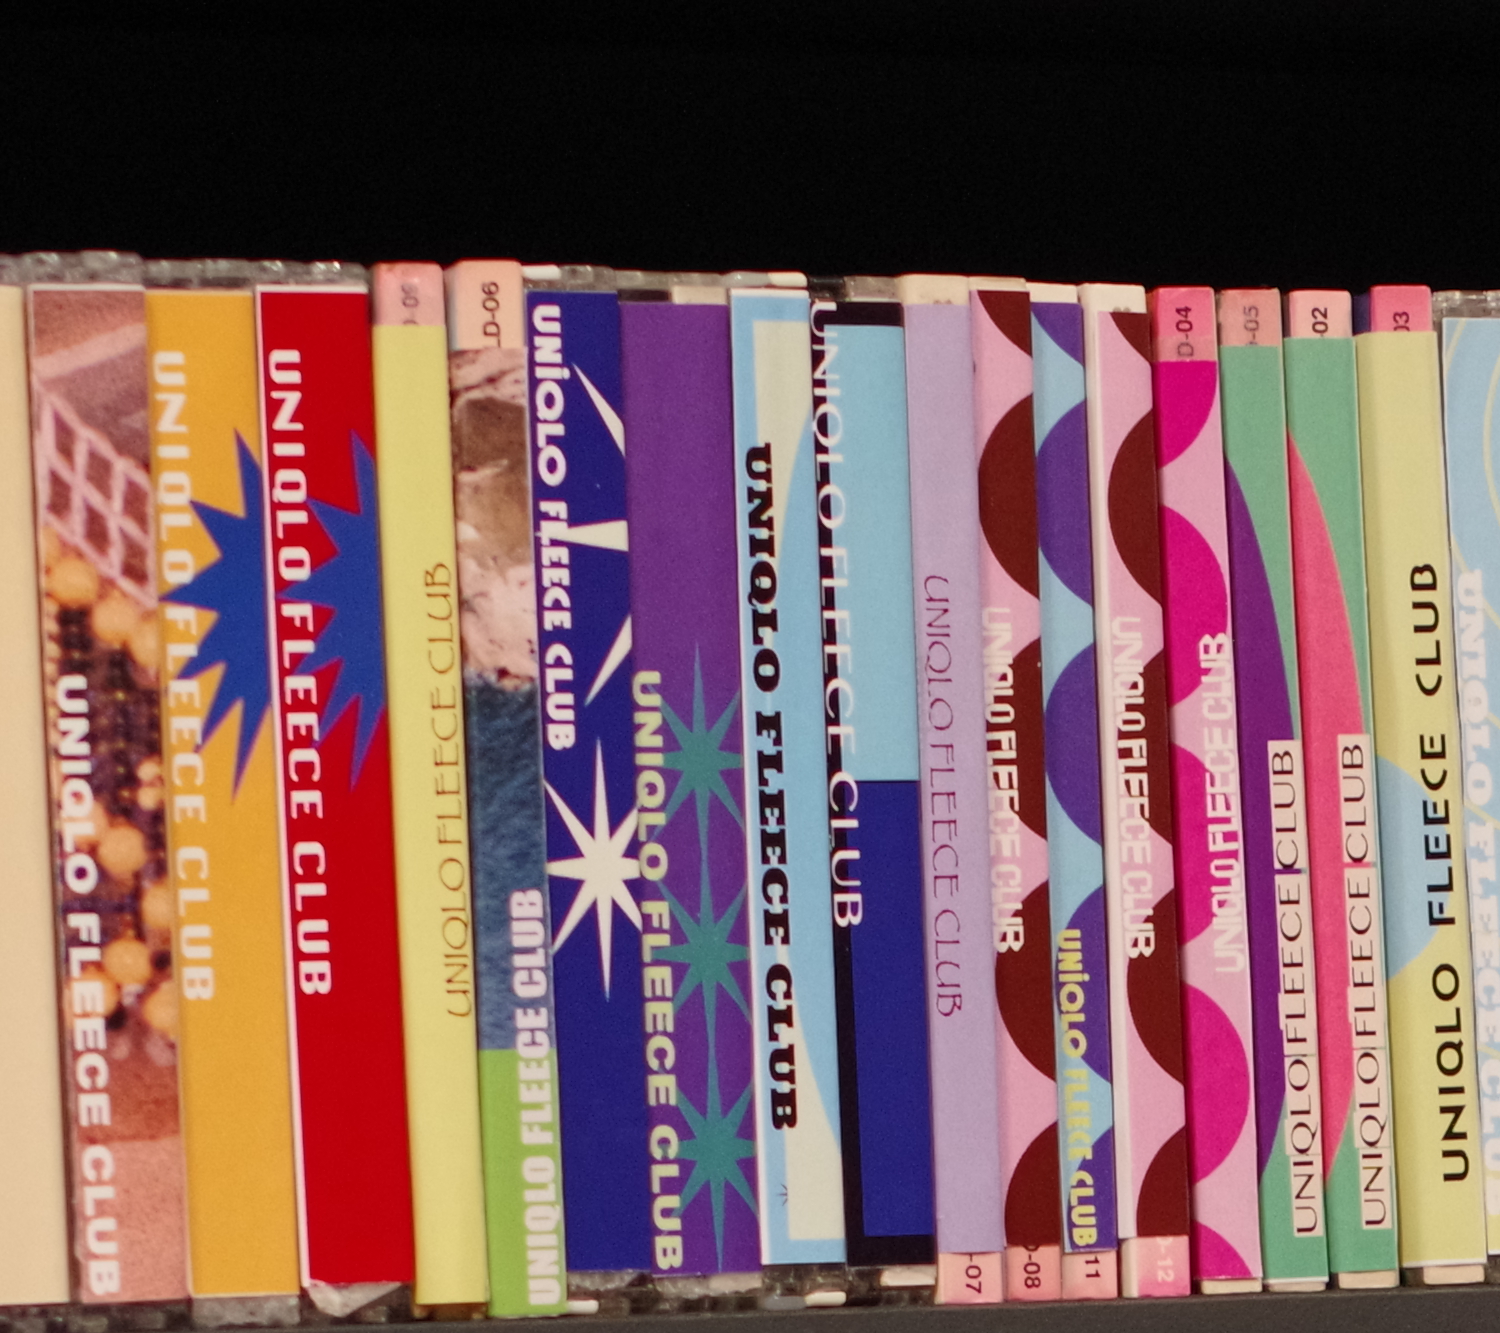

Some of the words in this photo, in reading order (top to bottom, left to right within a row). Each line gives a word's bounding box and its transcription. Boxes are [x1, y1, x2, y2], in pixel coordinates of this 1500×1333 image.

[152, 350, 196, 586] UNIQLO
[267, 348, 312, 582] UNIQLO
[809, 300, 847, 527] UNIQLO
[421, 562, 454, 675] CLUB
[536, 500, 574, 632] FLEECE
[745, 442, 781, 692] UNIQLO
[818, 536, 857, 754] FLEECE
[1410, 562, 1444, 697] CLUB
[163, 605, 208, 825] FLEECE
[279, 601, 324, 820] FLEECE
[543, 647, 577, 751] CLUB
[922, 574, 955, 733] UNIQLO
[56, 673, 98, 895] UNIQLO
[429, 682, 466, 846] FLEECE
[632, 670, 669, 882] UNIQLO
[754, 710, 790, 947] FLEECE
[928, 740, 961, 899] FLEECE
[1272, 749, 1299, 869] CLUB
[1342, 742, 1368, 863] CLUB
[1419, 732, 1457, 926] FLEECE
[175, 845, 215, 1001] CLUB
[291, 840, 334, 996] CLUB
[829, 771, 864, 929] CLUB
[437, 856, 472, 1018] UNIQLO
[509, 888, 549, 998] CLUB
[640, 900, 678, 1108] FLEECE
[933, 908, 964, 1018] CLUB
[1277, 882, 1309, 1045] FLEECE
[1346, 875, 1380, 1035] FLEECE
[67, 912, 112, 1128] FLEECE
[513, 1005, 554, 1146] FLEECE
[764, 963, 799, 1131] CLUB
[1431, 963, 1471, 1183] UNIQLO
[1062, 1066, 1094, 1162] FLEECE
[1287, 1056, 1320, 1236] UNIQLO
[1352, 1051, 1388, 1227] UNIQLO
[80, 1145, 121, 1297] CLUB
[521, 1155, 562, 1306] UNIQLO
[648, 1123, 684, 1272] CLUB
[1068, 1168, 1099, 1247] CLUB
